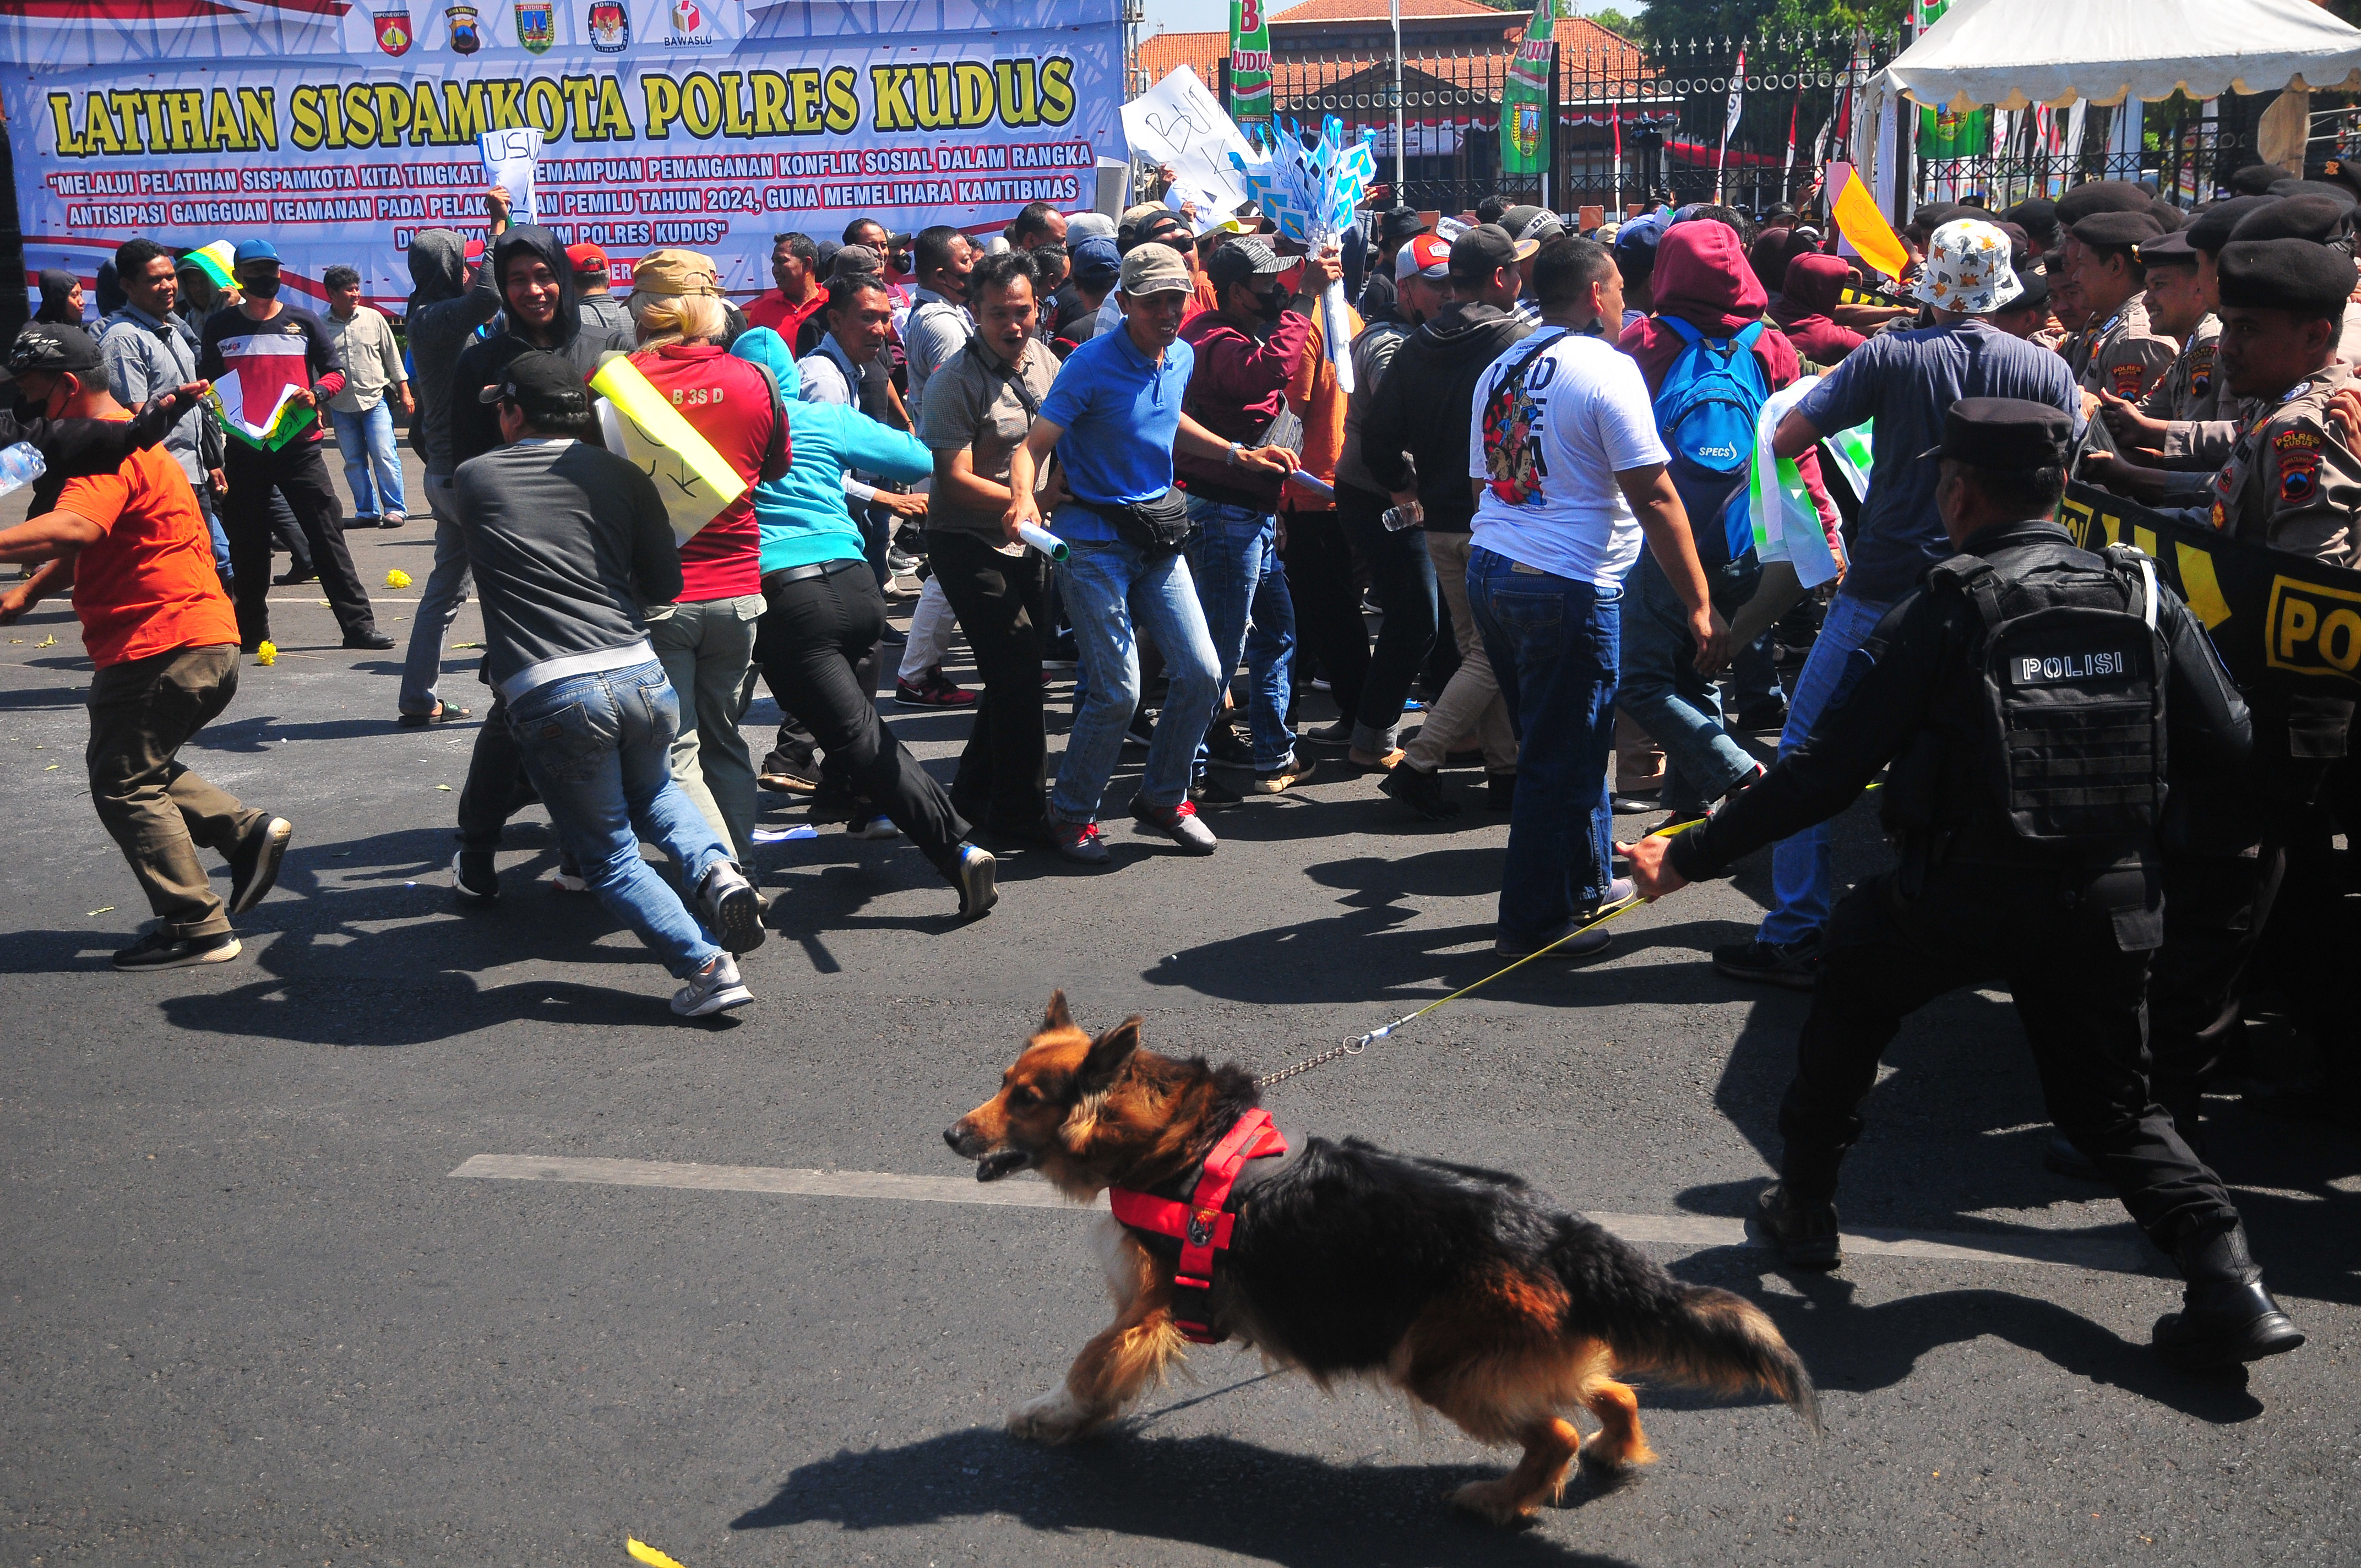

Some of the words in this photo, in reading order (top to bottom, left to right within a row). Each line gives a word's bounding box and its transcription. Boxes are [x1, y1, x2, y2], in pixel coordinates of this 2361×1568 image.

[665, 35, 712, 46] BAWASLU
[48, 87, 279, 157] LATIHAN
[291, 74, 634, 150] SISPAMKOTA
[642, 66, 859, 140] POLRES
[871, 57, 1075, 132] KUDUS
[49, 175, 134, 195] "MELALUI
[140, 171, 237, 193] PELATIHAN
[243, 168, 354, 190] SISPAMKOTA
[361, 166, 401, 187] KITA
[534, 160, 641, 182] EMAMPUAN
[648, 156, 773, 180] PENANGANAN
[780, 154, 859, 175] KONFLIK
[867, 150, 932, 172] SOSIAL
[940, 148, 1005, 170] DALAM
[1013, 144, 1091, 167] RANGKA
[70, 205, 165, 226] ANTISIPASI
[171, 202, 268, 224] GANGGUAN
[275, 199, 371, 221] KEAMANAN
[379, 197, 424, 219] PADA
[565, 192, 633, 213] PEMILU
[639, 190, 702, 211] TAHUN
[708, 188, 761, 212] 2024,
[766, 187, 818, 209] GUNA
[824, 183, 953, 206] MEMELIHARA
[959, 177, 1077, 202] KAMTIBMAS
[580, 226, 649, 244] POLRES
[657, 222, 726, 241] KUDUS"
[2114, 365, 2141, 374] POLRES
[2276, 433, 2320, 447] POLRES
[2284, 440, 2313, 448] KUDUS
[1699, 447, 1730, 457] SPECS
[2022, 651, 2123, 680] POLISI
